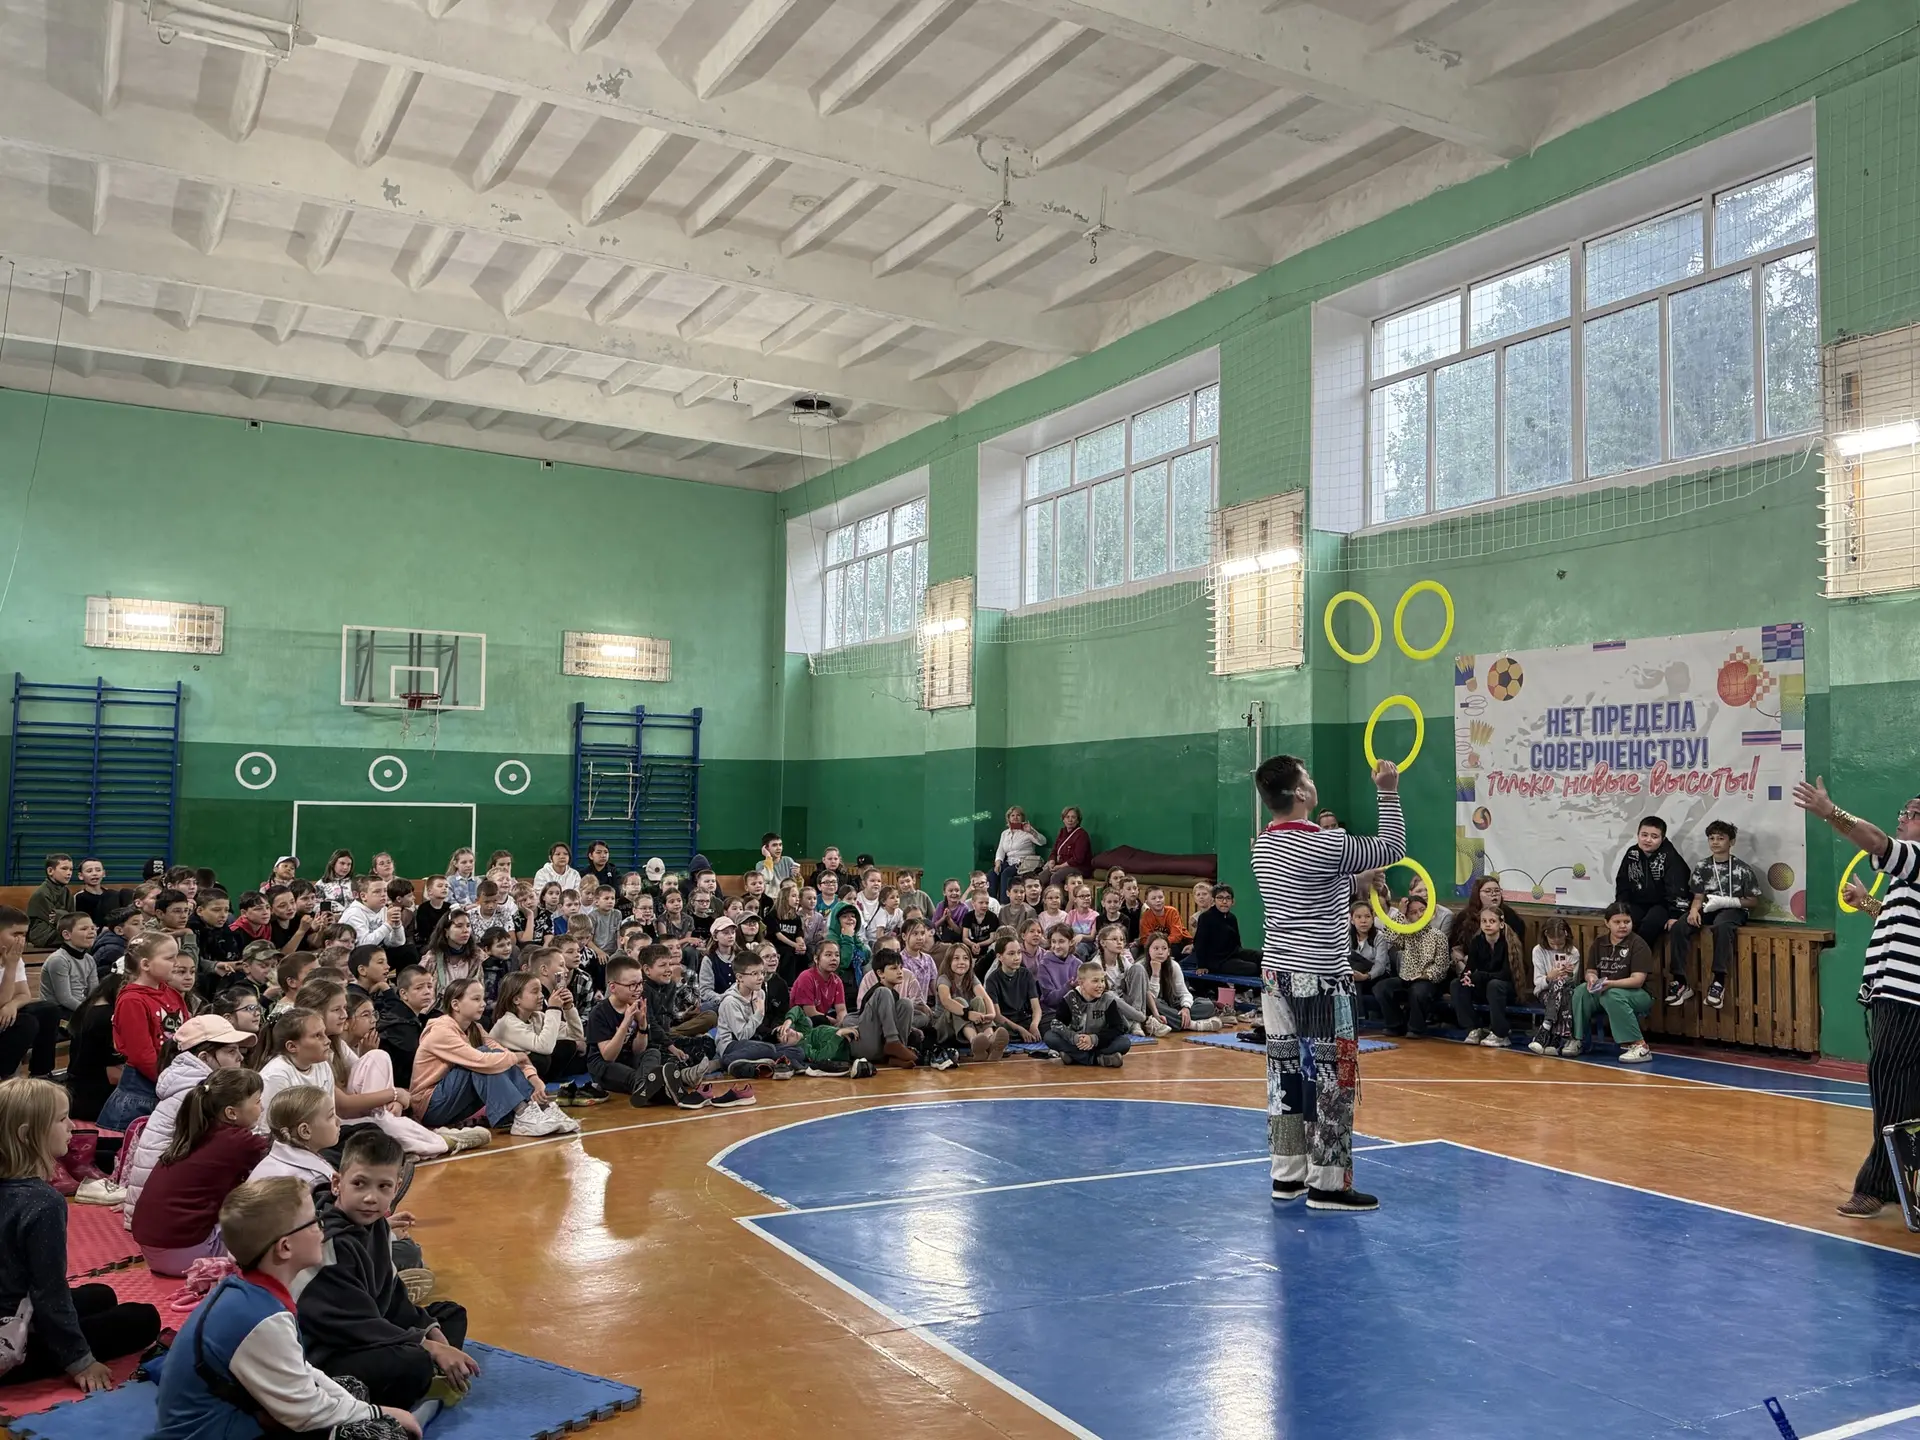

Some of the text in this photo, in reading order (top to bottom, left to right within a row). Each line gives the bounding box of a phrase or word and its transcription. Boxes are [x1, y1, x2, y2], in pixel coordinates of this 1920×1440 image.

[1546, 700, 1697, 737] НЕТ ПРЕДЕЛА
[1530, 737, 1709, 772] СОВЕРШЕНСТВУ!
[1562, 760, 1641, 798] новые
